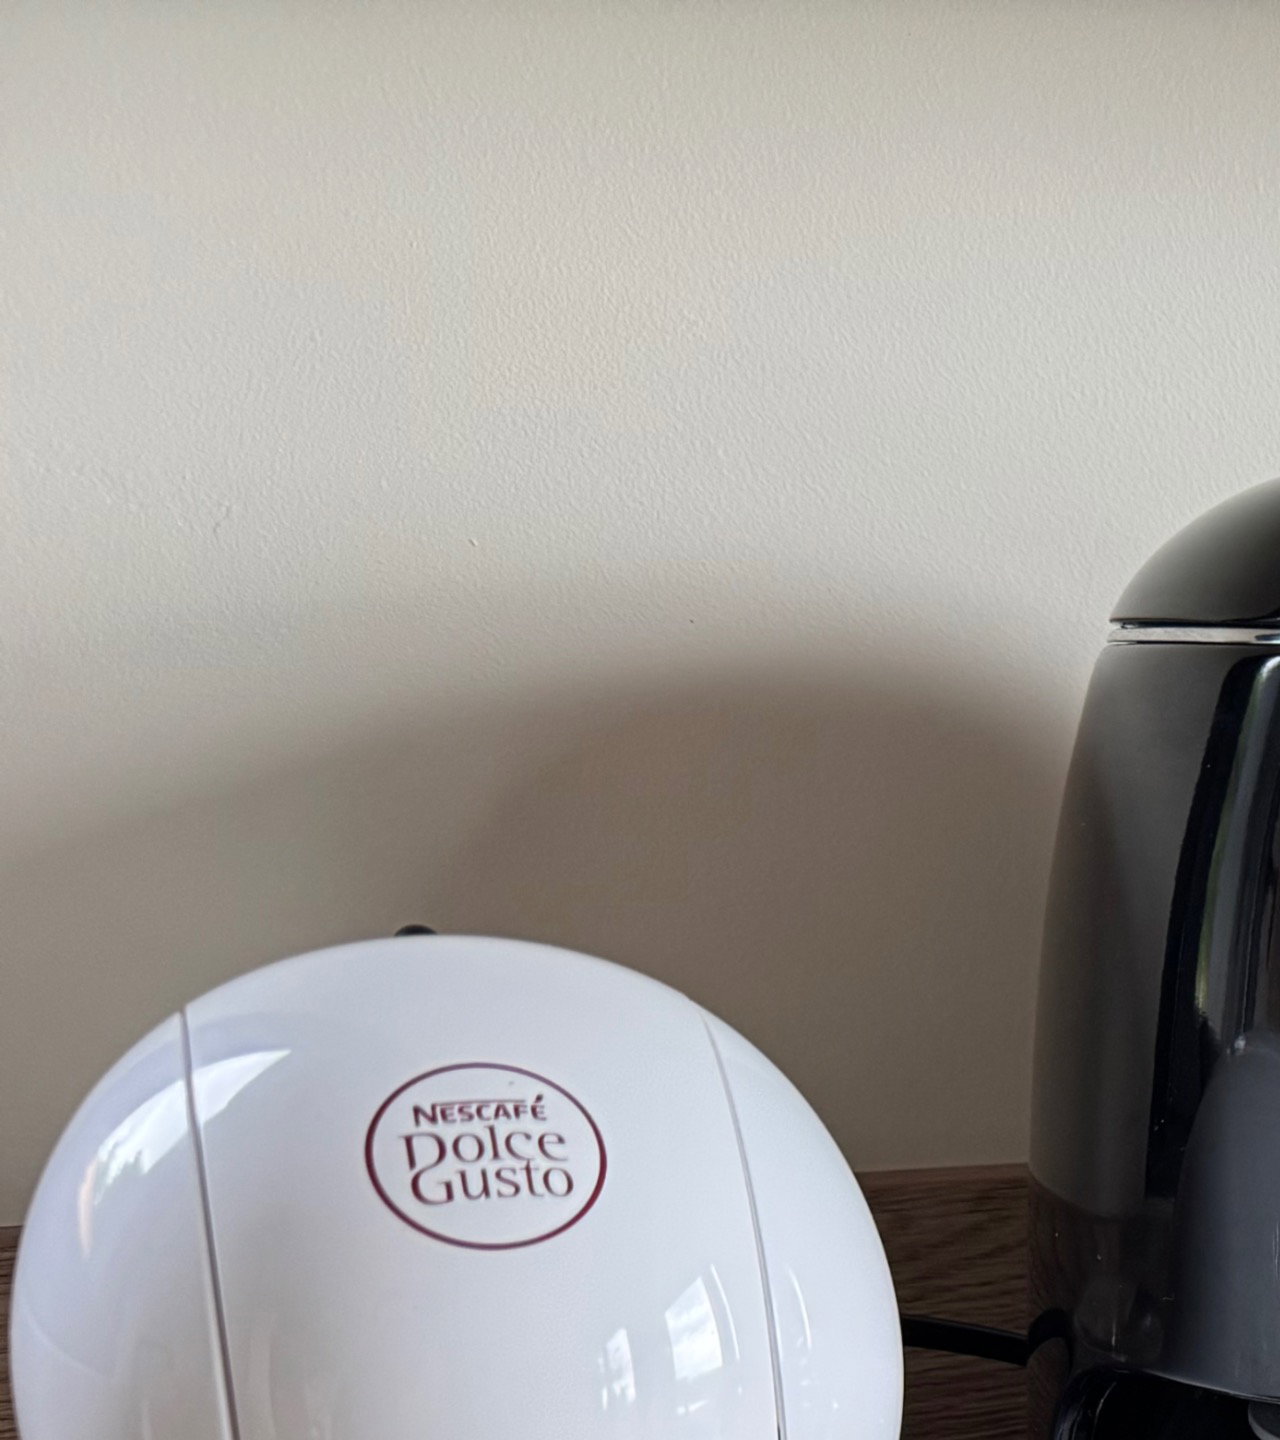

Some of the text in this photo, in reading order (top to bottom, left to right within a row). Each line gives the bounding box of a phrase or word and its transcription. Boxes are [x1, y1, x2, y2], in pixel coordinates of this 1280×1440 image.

[412, 1094, 548, 1127] NESCAFÉ
[399, 1124, 569, 1171] Dolce
[410, 1159, 575, 1206] Gusto
